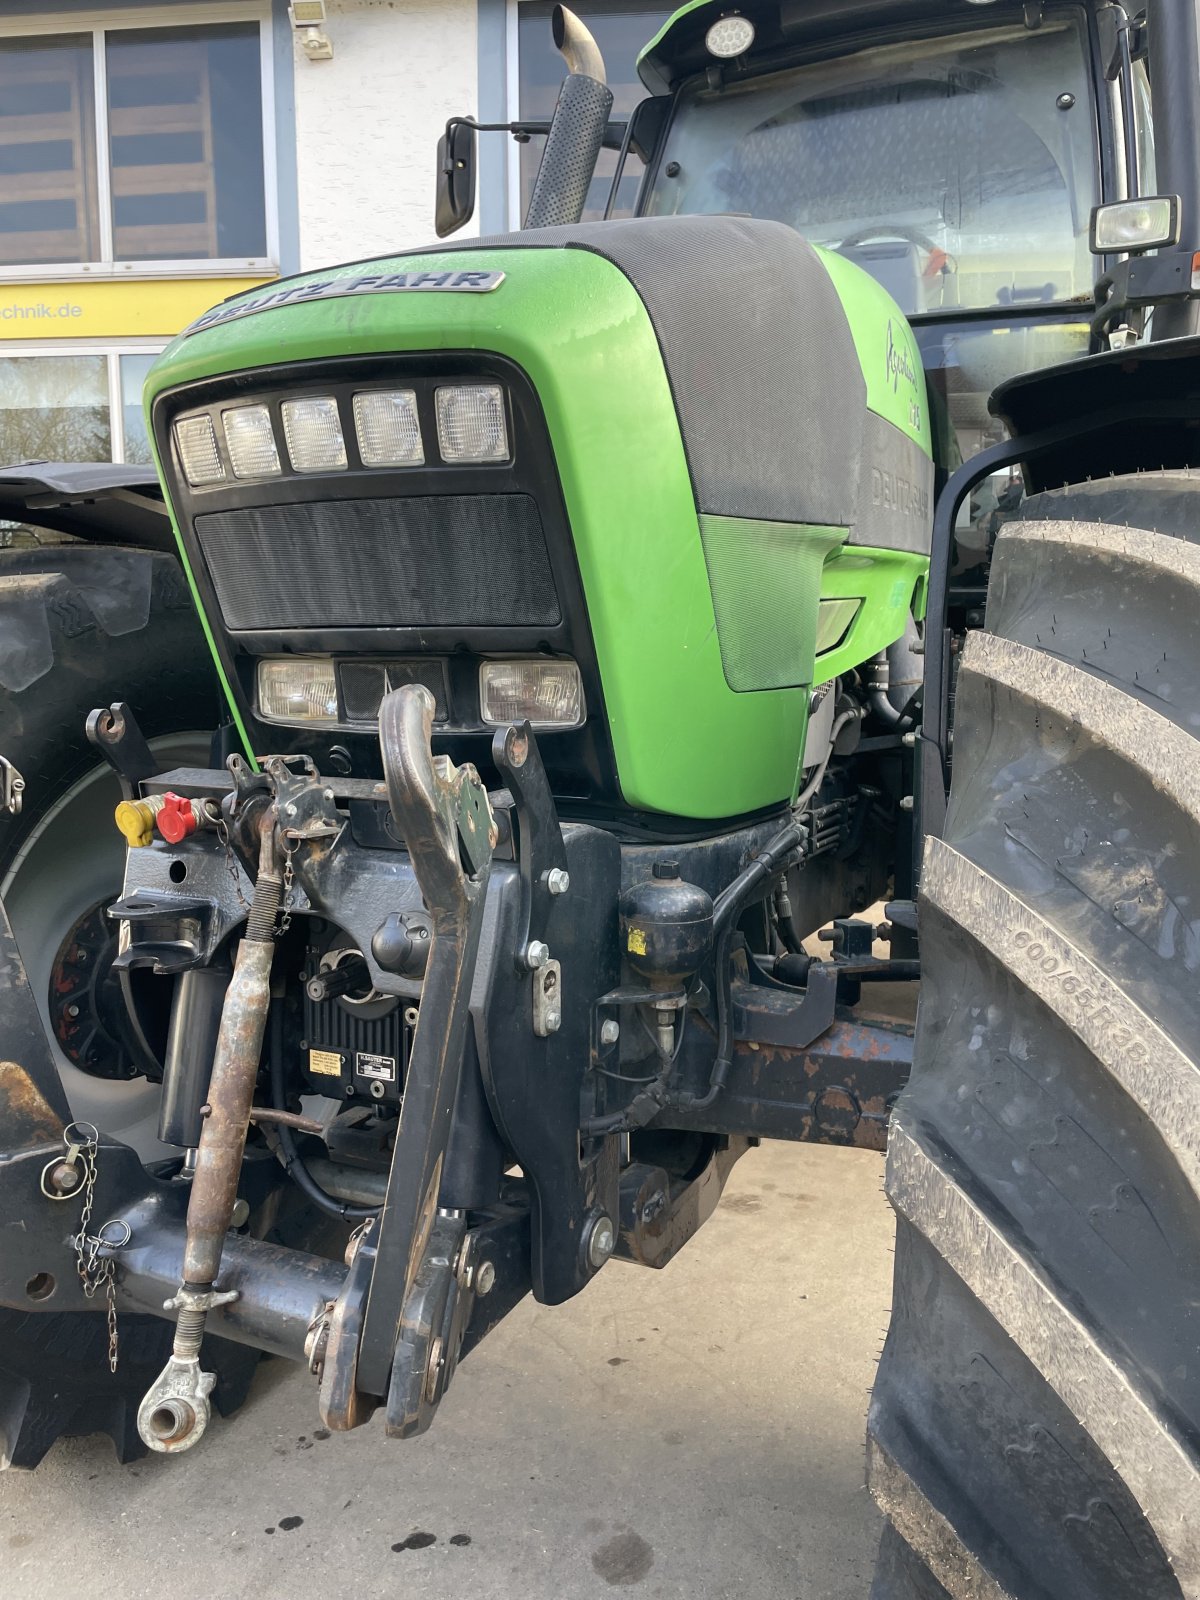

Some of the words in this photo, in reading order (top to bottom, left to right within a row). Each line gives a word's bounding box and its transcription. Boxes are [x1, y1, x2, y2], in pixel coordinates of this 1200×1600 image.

[0, 303, 82, 320] chnik.de
[189, 281, 334, 330] DEUTZ
[346, 271, 492, 291] FAHR
[1013, 931, 1096, 1009] 600/65
